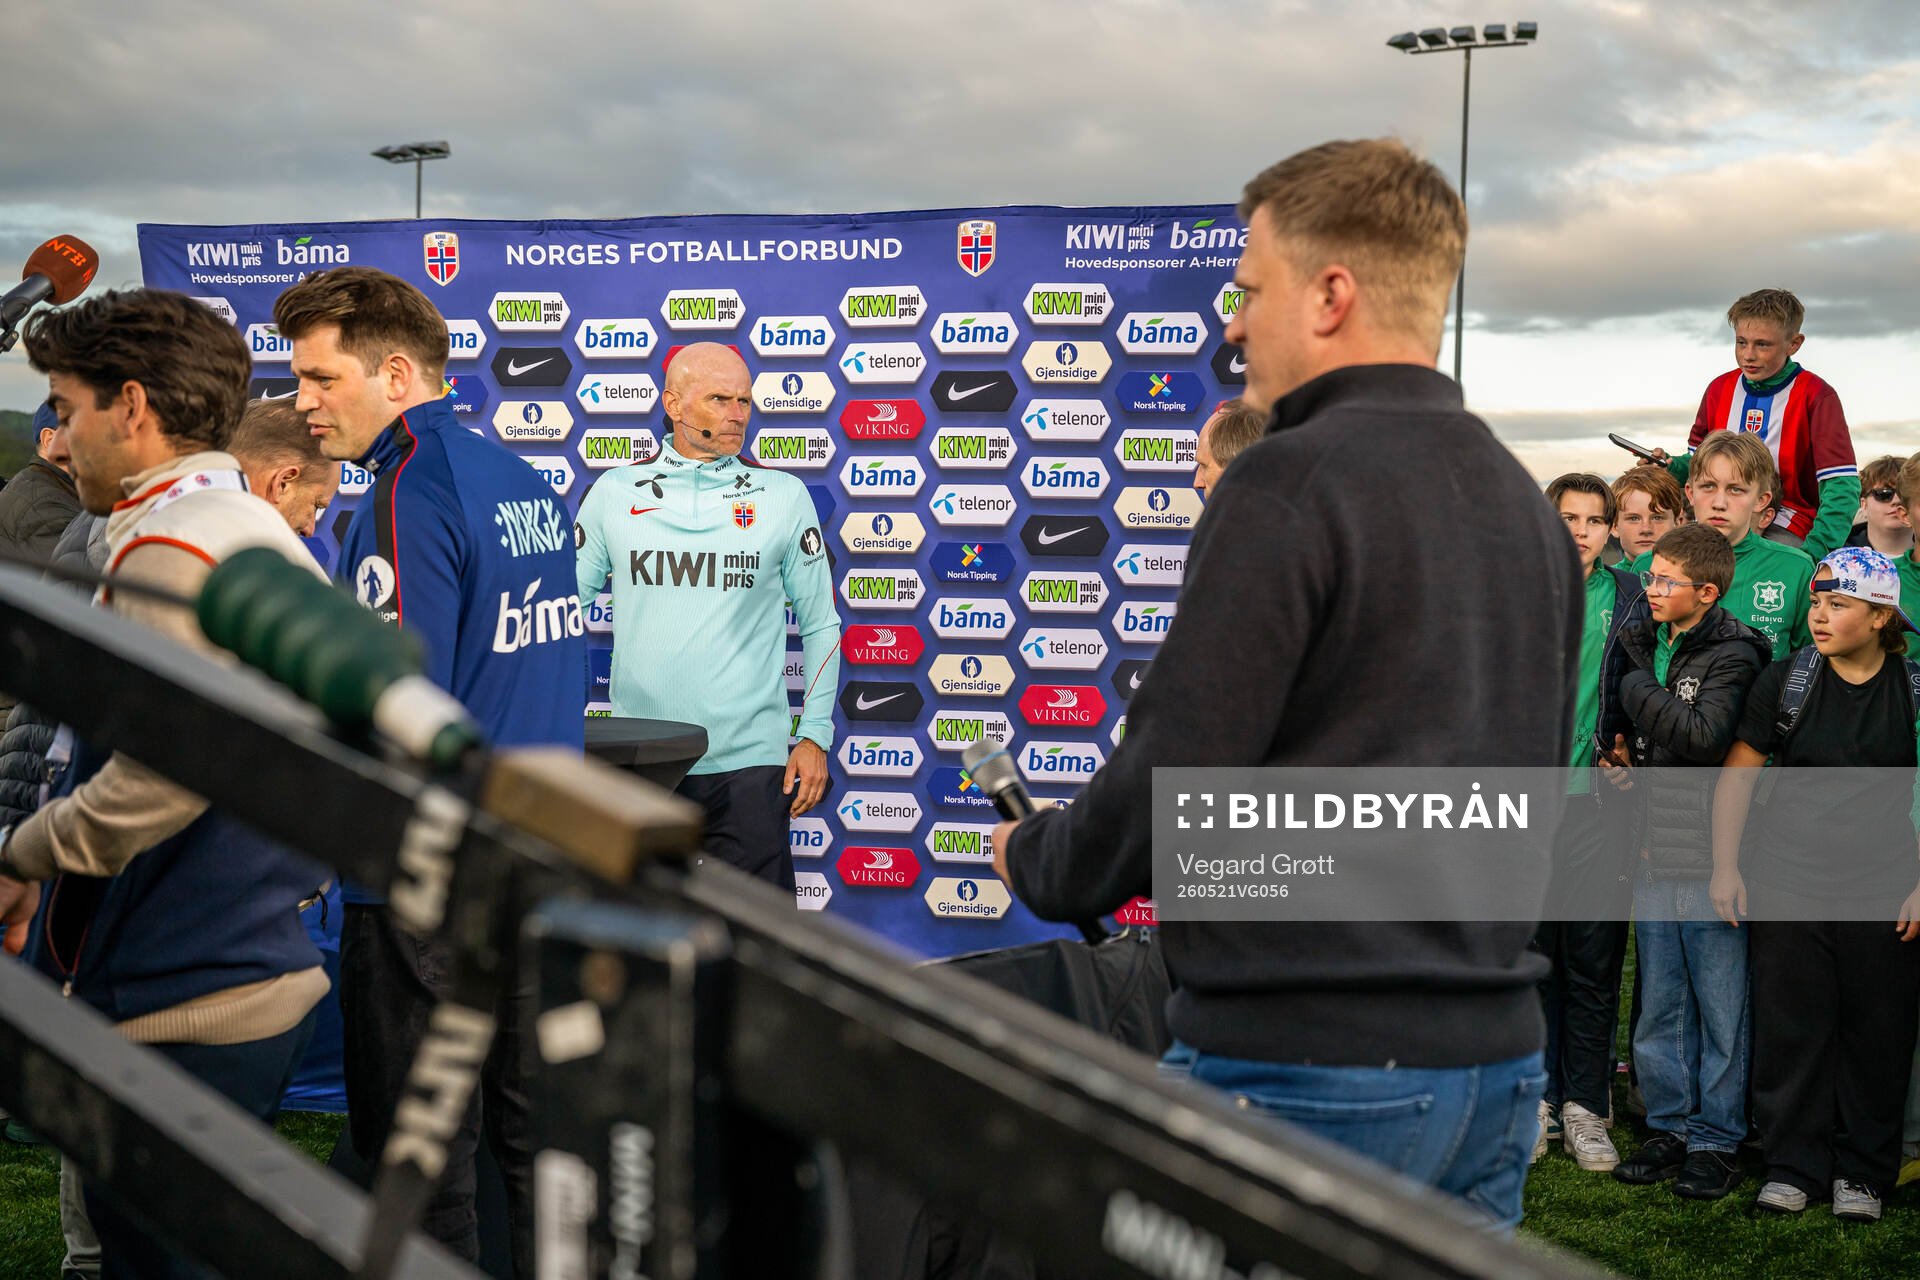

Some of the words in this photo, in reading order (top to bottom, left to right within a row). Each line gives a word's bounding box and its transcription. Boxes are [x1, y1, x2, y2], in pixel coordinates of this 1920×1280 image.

[1066, 225, 1124, 249] KIWI
[1128, 224, 1154, 236] mini
[506, 244, 620, 265] NORGES
[629, 238, 903, 264] FOTBALLFORBUND
[1128, 237, 1150, 252] pris
[187, 243, 239, 266] KIWI
[241, 242, 262, 254] mini
[242, 254, 262, 268] pris
[1066, 256, 1185, 271] Hovedsponsorer
[191, 272, 294, 286] Hovedsponsorer
[670, 298, 715, 320] KIWI
[718, 298, 738, 310] mini
[848, 294, 896, 318] KIWI
[898, 294, 920, 306] mini
[1032, 292, 1081, 315] KIWI
[1084, 292, 1106, 304] mini
[1222, 291, 1246, 314] KI
[496, 300, 541, 322] KIWI
[543, 300, 563, 312] mini
[718, 310, 736, 322] pris
[898, 306, 917, 319] pris
[1084, 304, 1103, 317] pris
[544, 312, 561, 324] pris
[252, 330, 292, 352] bam
[448, 332, 478, 348] ma
[869, 354, 922, 368] telenor
[1036, 366, 1097, 380] Gjensidige
[604, 384, 654, 399] telenor
[763, 396, 822, 409] Gjensidige
[1134, 402, 1155, 410] Norsk
[1157, 402, 1186, 412] Tipping
[1052, 411, 1106, 426] telenor
[505, 425, 561, 438] Gjensidige
[855, 424, 909, 436] VIKING
[586, 437, 631, 458] KIWI
[633, 436, 652, 448] mini
[633, 448, 650, 460] pris
[759, 436, 806, 459] KIWI
[808, 436, 828, 448] mini
[809, 448, 826, 460] pris
[938, 436, 986, 459] KIWI
[988, 436, 1010, 448] mini
[1124, 438, 1172, 462] KIWI
[1176, 438, 1197, 451] mini
[989, 448, 1007, 461] pris
[1176, 451, 1195, 464] pris
[959, 496, 1011, 511] telenor
[1128, 512, 1190, 525] Gjensidige
[853, 537, 912, 550] Gjensidige
[630, 550, 716, 588] KIWI
[724, 551, 760, 569] mini
[1144, 556, 1187, 571] telen
[724, 570, 755, 592] pris
[947, 571, 968, 579] Norsk
[970, 571, 997, 581] Tipping
[849, 576, 895, 599] KIWI
[898, 577, 918, 589] mini
[898, 588, 915, 601] pris
[1028, 580, 1077, 604] KIWI
[1080, 580, 1101, 592] mini
[1080, 592, 1099, 605] pris
[1124, 608, 1175, 632] bam
[854, 648, 908, 660] VIKING
[1049, 641, 1103, 655] telenor
[941, 679, 1001, 692] Gjensidige
[1034, 709, 1090, 721] VIKING
[936, 718, 984, 741] KIWI
[986, 720, 1006, 732] mini
[866, 804, 917, 818] telenor
[790, 830, 823, 846] ma
[934, 830, 980, 854] KIWI
[851, 871, 905, 883] VIKING
[796, 886, 827, 897] enor
[938, 902, 997, 916] Gjensidige
[1124, 910, 1156, 920] VIKI
